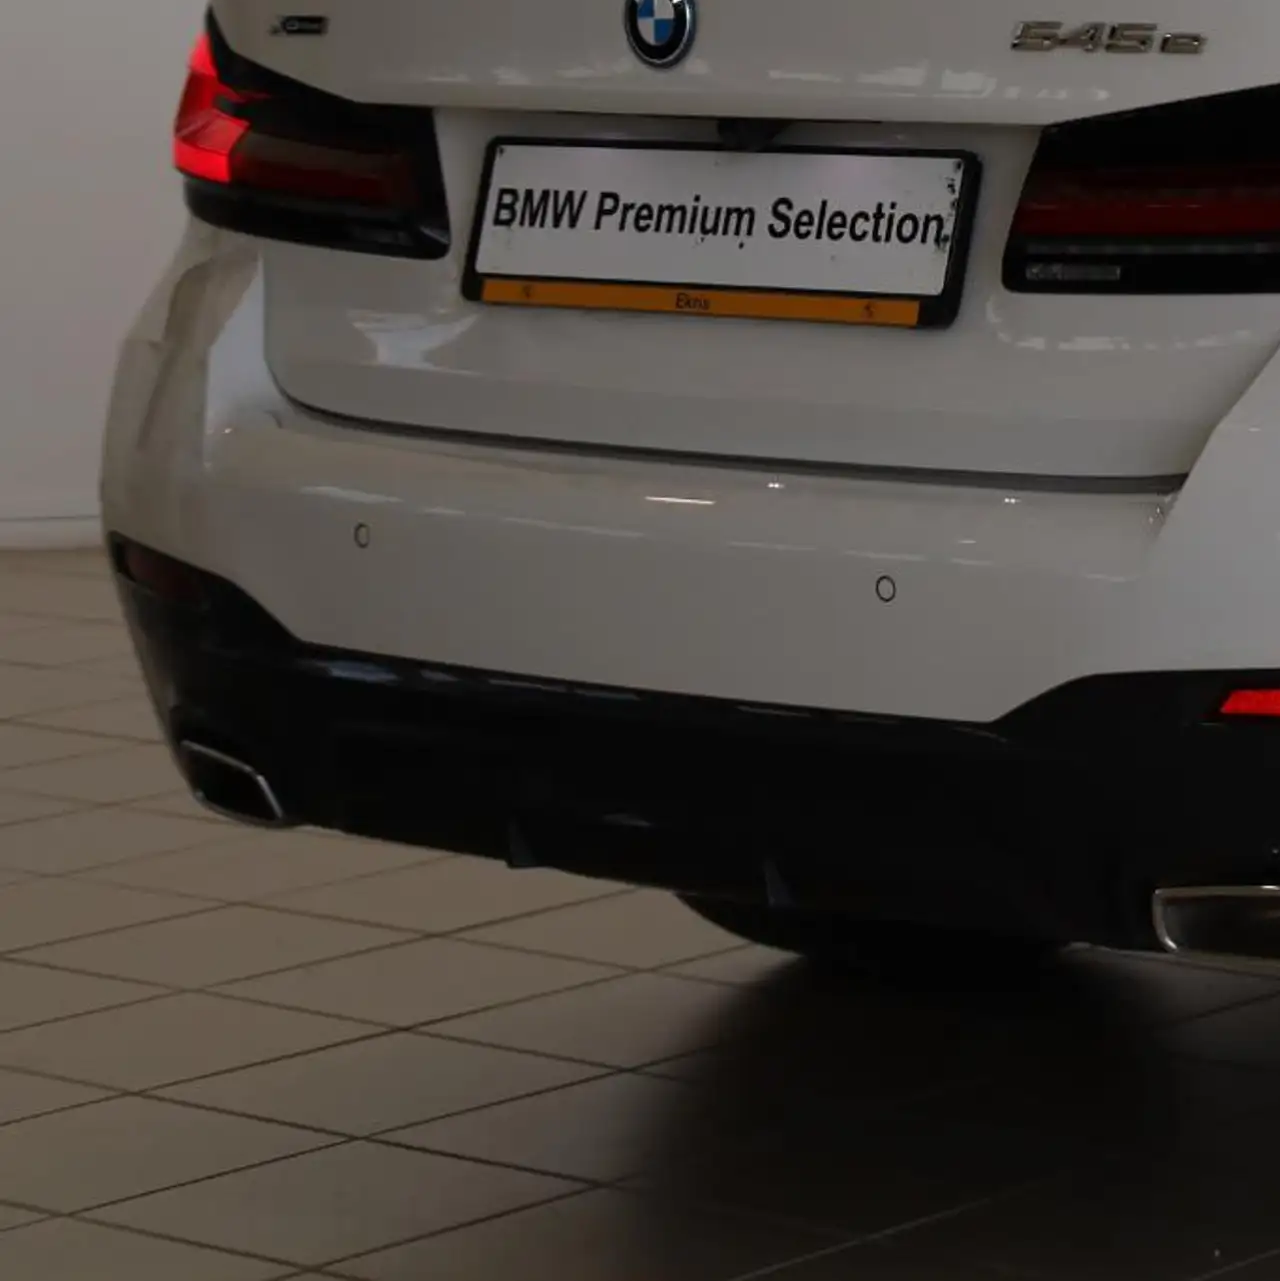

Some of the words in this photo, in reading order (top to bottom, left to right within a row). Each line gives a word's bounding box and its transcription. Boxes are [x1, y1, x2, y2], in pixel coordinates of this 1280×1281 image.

[493, 188, 588, 229] BMW
[594, 191, 756, 237] Premium
[767, 197, 945, 246] Selection
